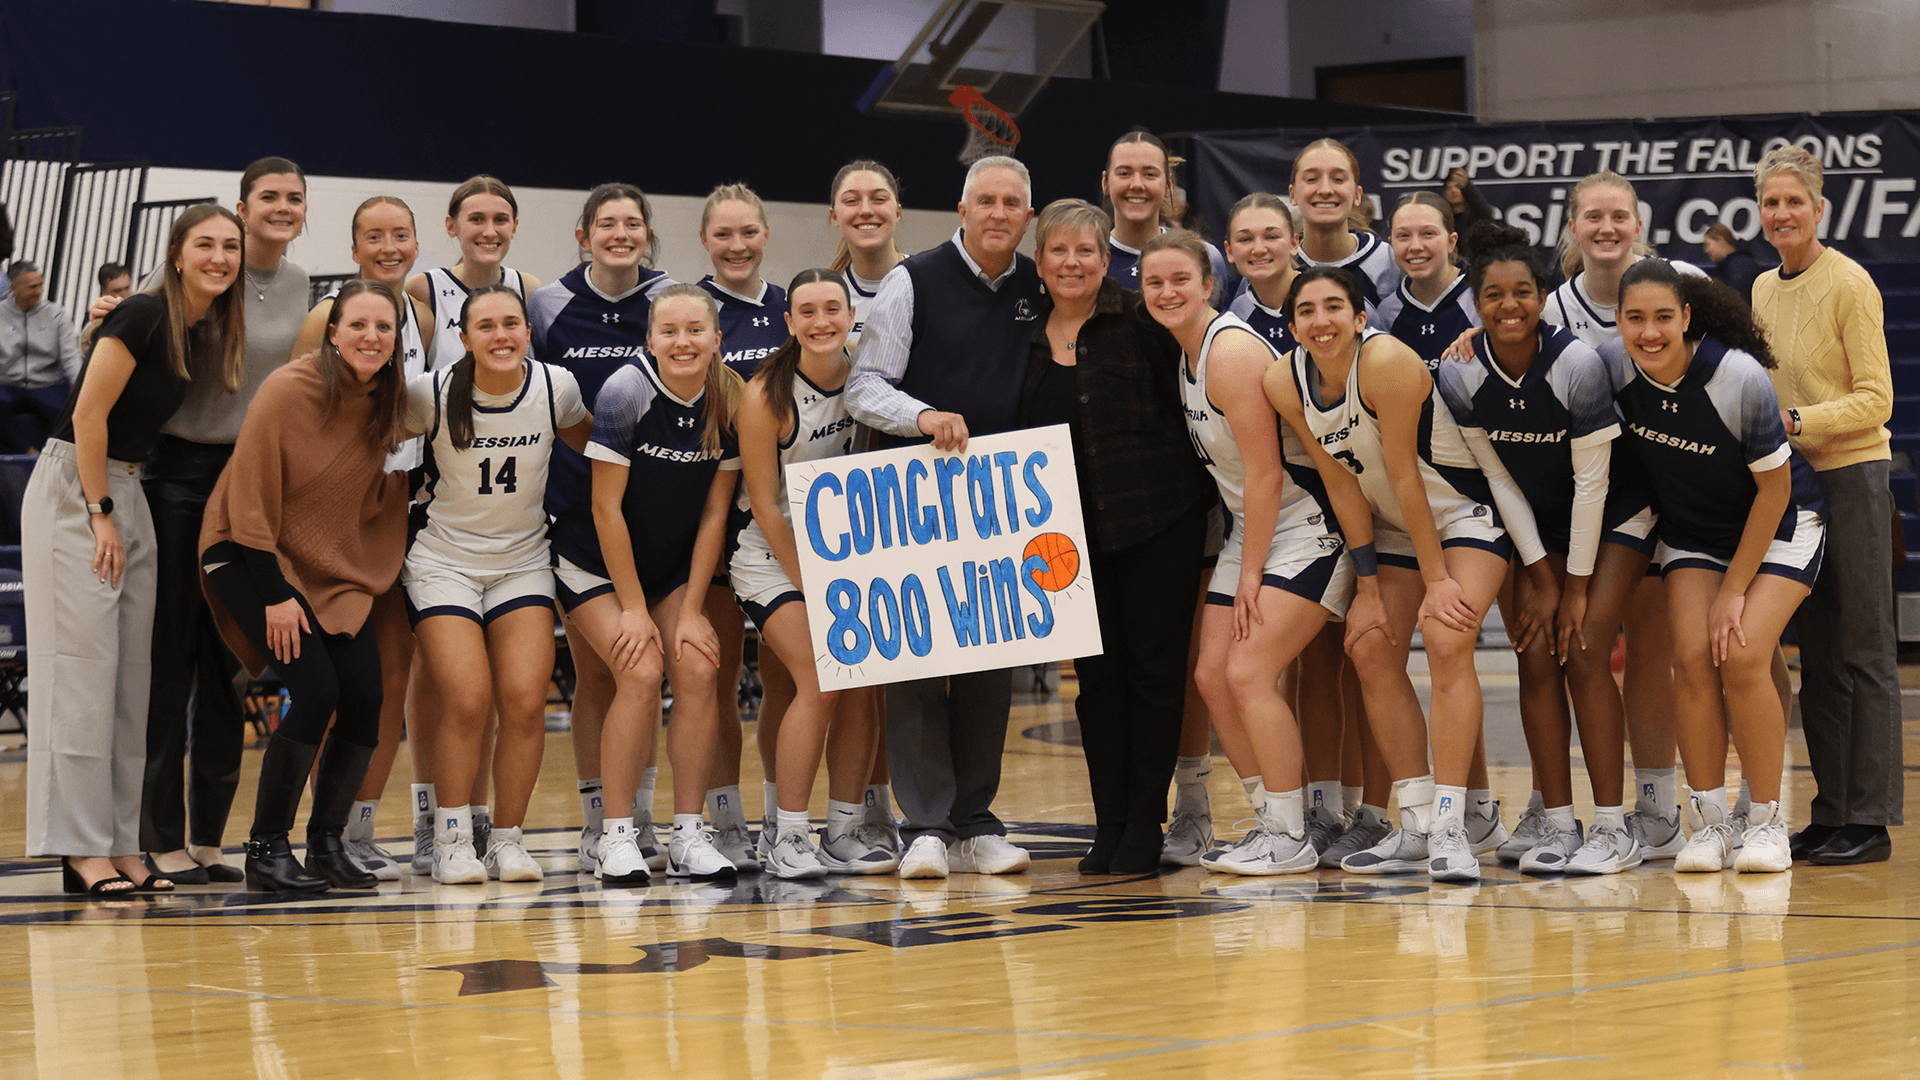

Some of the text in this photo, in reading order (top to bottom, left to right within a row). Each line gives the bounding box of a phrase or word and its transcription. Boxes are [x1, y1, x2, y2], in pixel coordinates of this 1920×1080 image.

[1381, 143, 1585, 181] SUPPORT
[1593, 140, 1679, 175] THE
[563, 346, 644, 359] MESSIA
[722, 346, 781, 363] MESS
[472, 432, 541, 449] ESSIAH
[808, 415, 857, 442] MESS
[1629, 422, 1716, 455] MESSIAH
[478, 456, 517, 495] 14
[826, 573, 933, 665] 800
